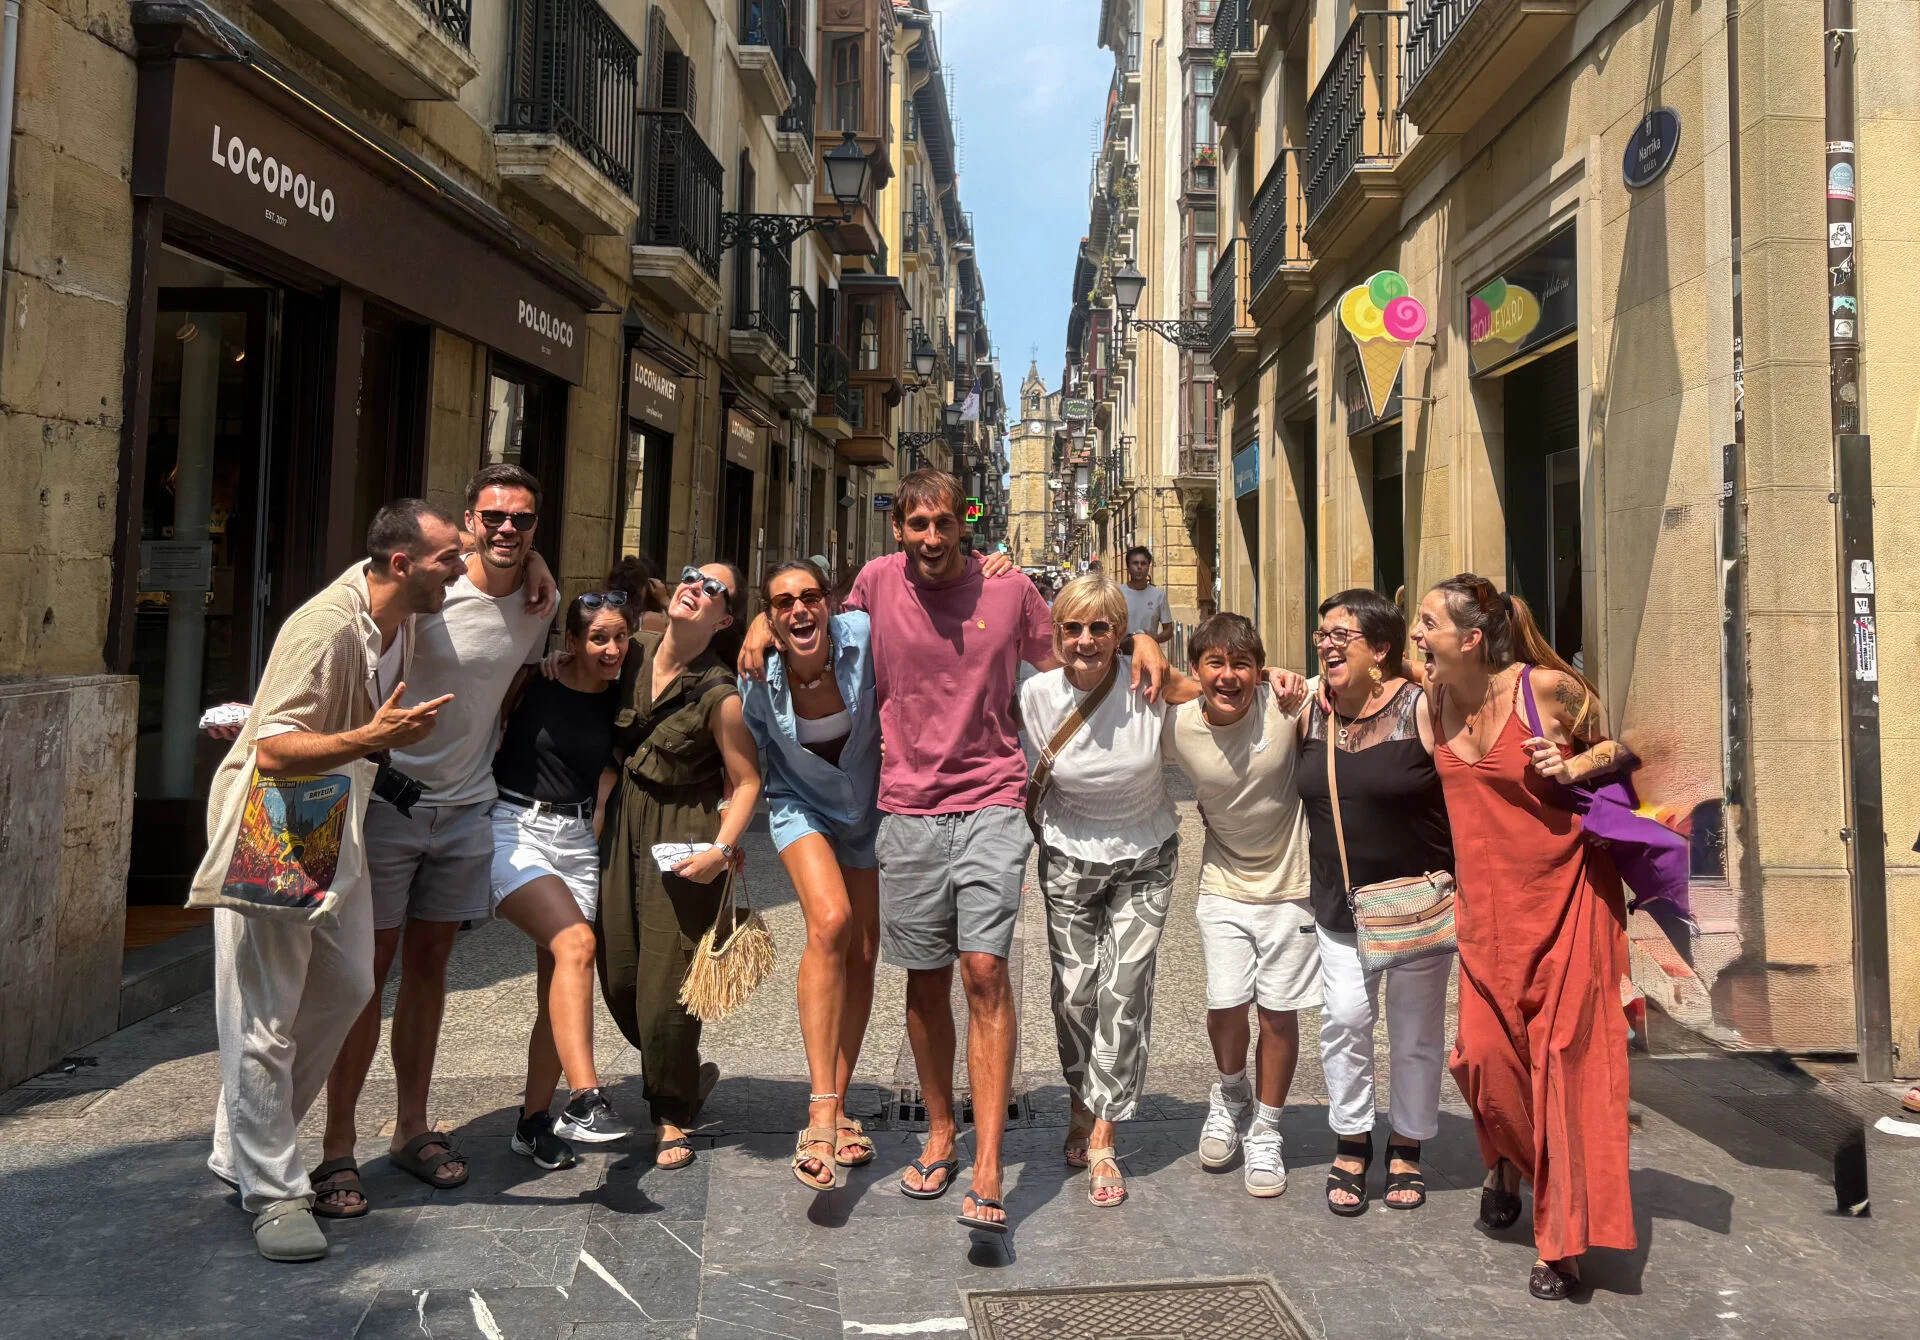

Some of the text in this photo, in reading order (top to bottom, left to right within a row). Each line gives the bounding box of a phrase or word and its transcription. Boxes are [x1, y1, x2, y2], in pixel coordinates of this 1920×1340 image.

[1639, 138, 1661, 162] Narrika
[212, 124, 335, 222] LOCOPOLO
[265, 209, 276, 222] EST.
[518, 299, 573, 348] POLOLOCO
[1471, 296, 1524, 345] BOULEVARD
[634, 362, 677, 401] LOCOMARKET
[308, 786, 334, 799] BAYEUX
